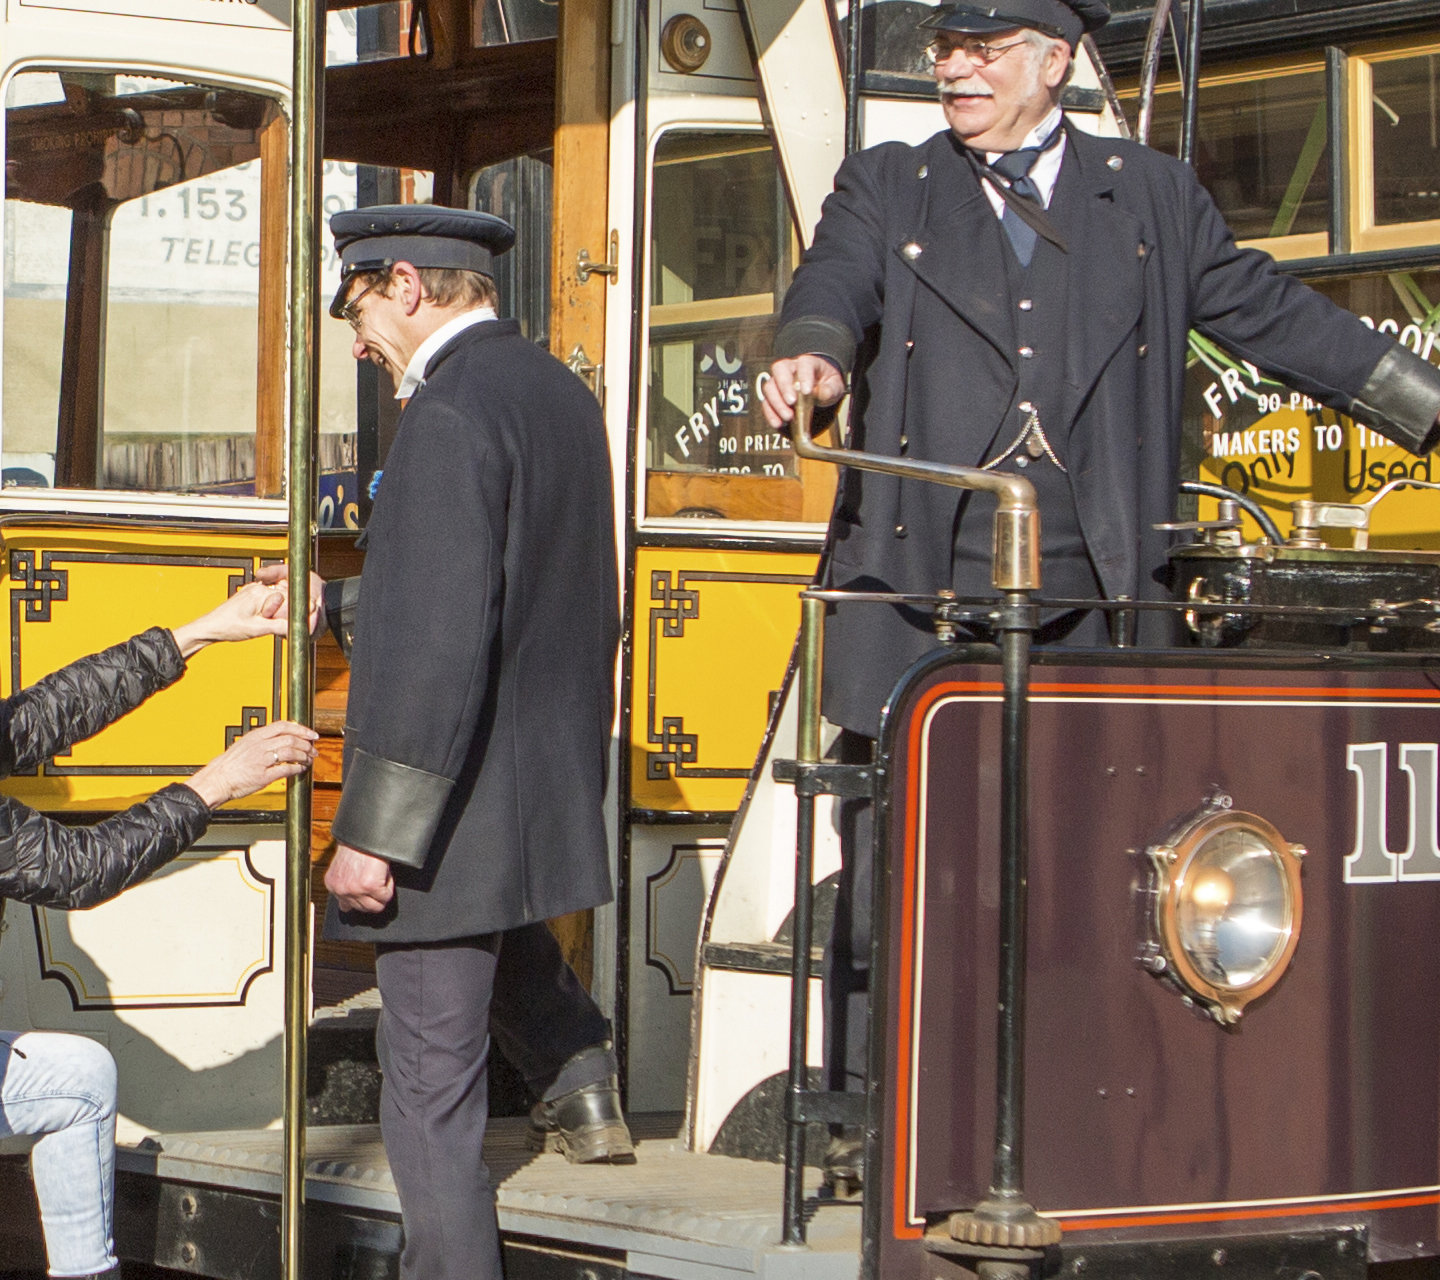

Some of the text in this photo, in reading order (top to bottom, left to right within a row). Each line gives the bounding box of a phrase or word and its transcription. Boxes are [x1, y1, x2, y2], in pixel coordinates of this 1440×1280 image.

[1258, 393, 1281, 413] 90
[675, 384, 744, 457] FRY'S
[719, 436, 737, 455] 90
[1213, 427, 1300, 458] MAKERS
[1313, 425, 1342, 451] TO
[1344, 449, 1431, 494] Used
